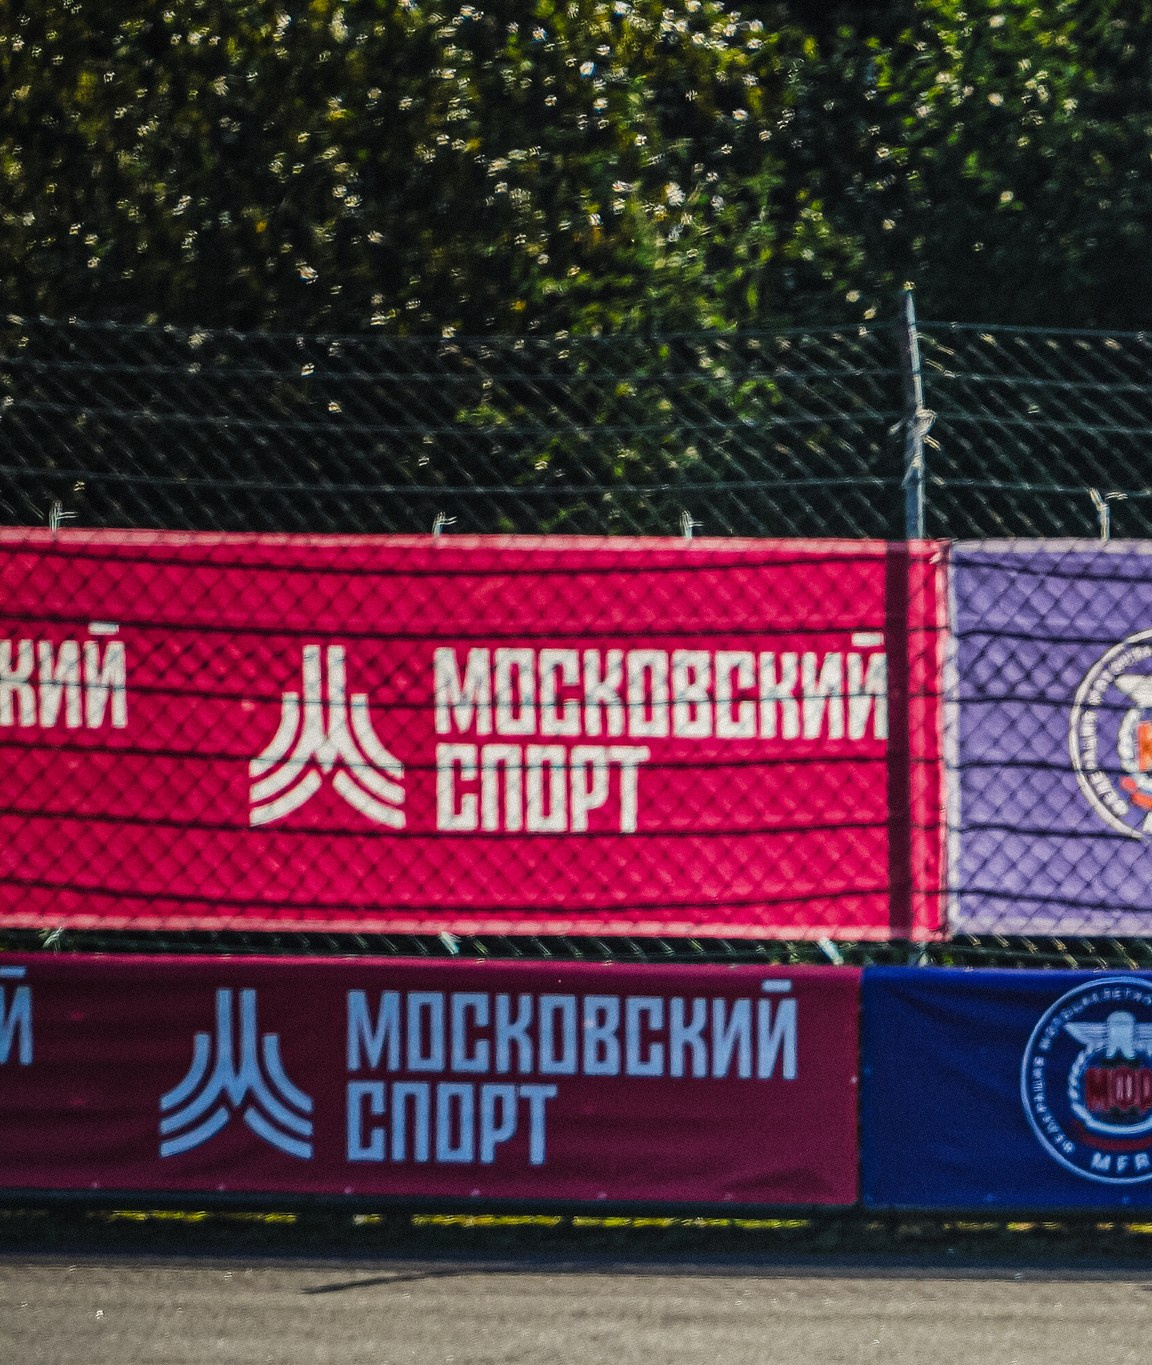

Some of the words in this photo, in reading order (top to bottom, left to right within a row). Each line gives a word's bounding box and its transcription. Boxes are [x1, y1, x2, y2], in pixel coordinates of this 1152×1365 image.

[433, 632, 888, 739] МОСКОВСКИЙ
[435, 742, 650, 833] СПОРТ
[346, 979, 798, 1080] МОСКОВСКИЙ
[346, 1081, 558, 1165] СПОРТ
[1090, 1152, 1150, 1173] MFR
